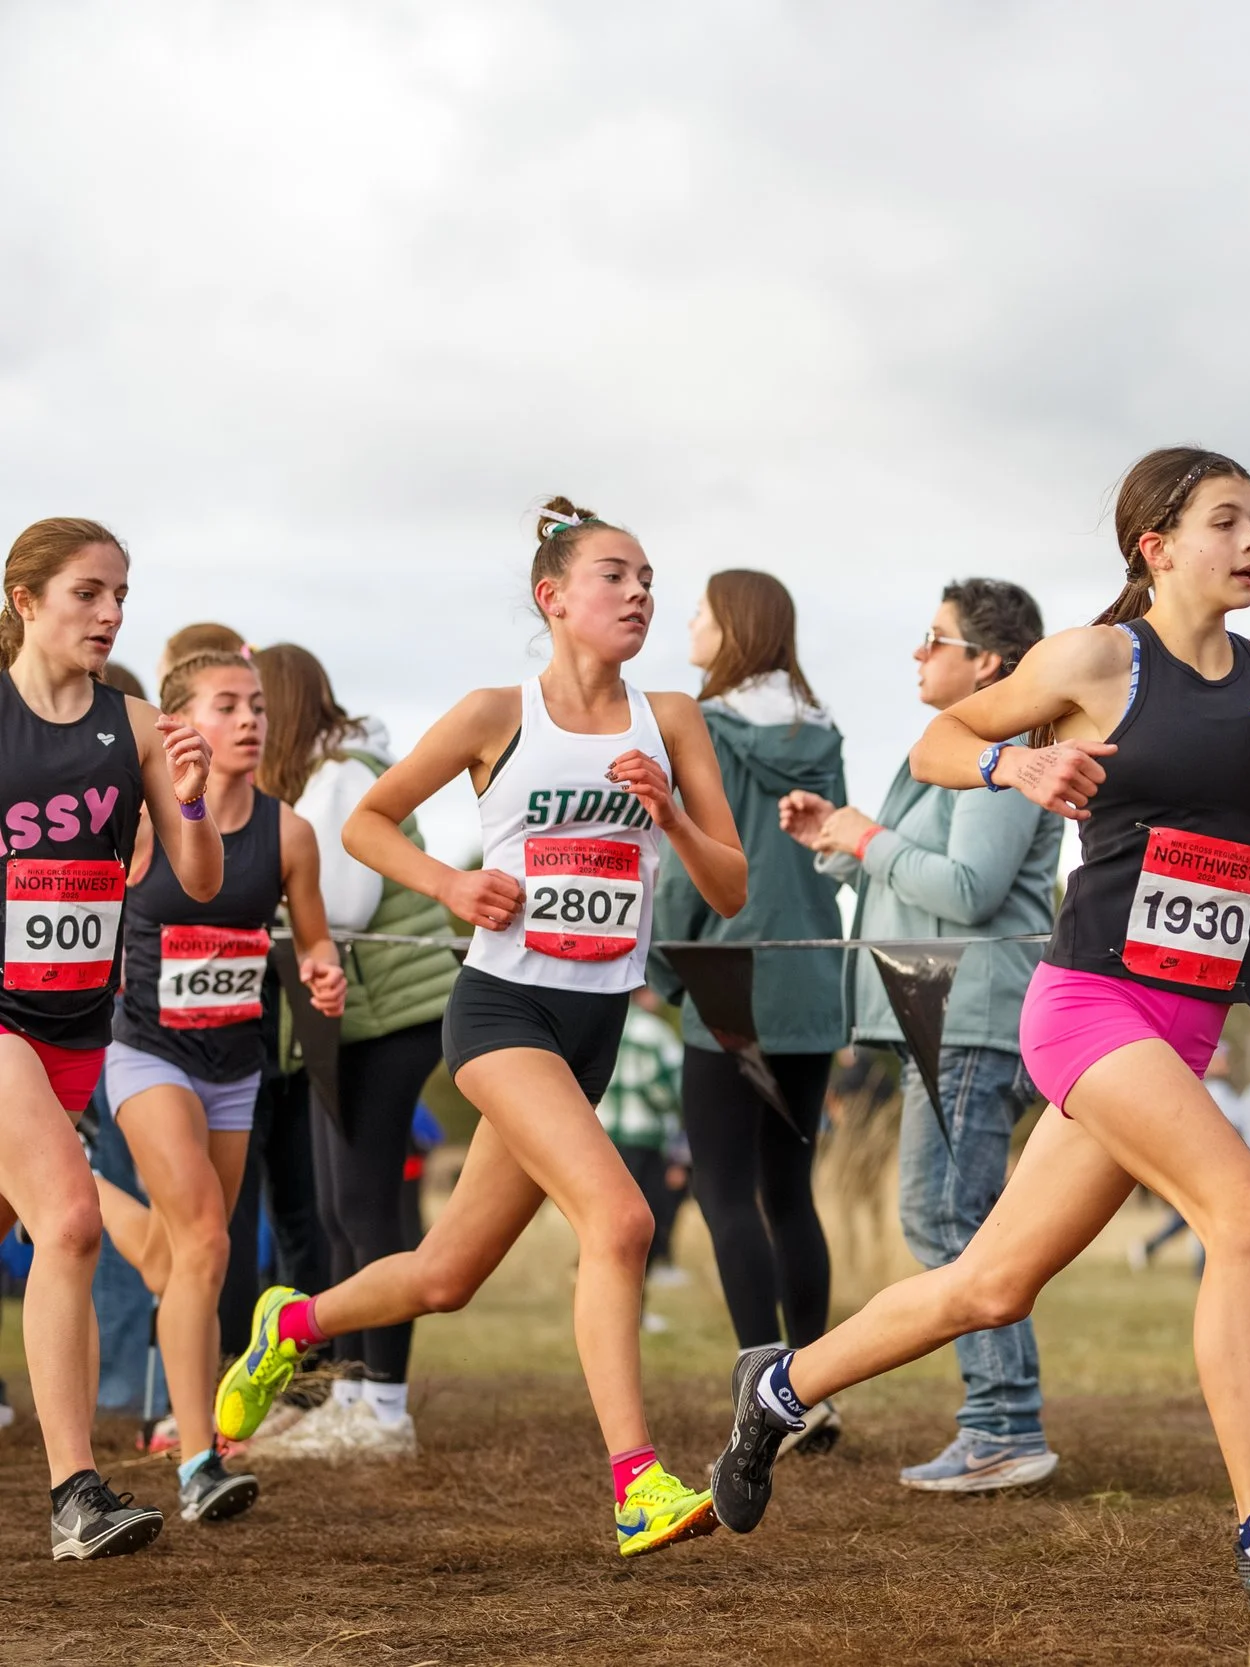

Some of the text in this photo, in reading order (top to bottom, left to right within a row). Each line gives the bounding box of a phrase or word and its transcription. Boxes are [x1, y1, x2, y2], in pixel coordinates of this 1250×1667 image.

[0, 785, 119, 858] SSY
[1171, 840, 1187, 850] NIKE
[1189, 844, 1212, 855] CROSS
[533, 853, 632, 873] NORTHWEST
[15, 876, 118, 891] NORTHWEST
[1197, 872, 1216, 883] 2025
[531, 887, 637, 926] 2807
[1143, 890, 1244, 945] 1930
[26, 914, 102, 950] 900
[170, 968, 257, 996] 1682
